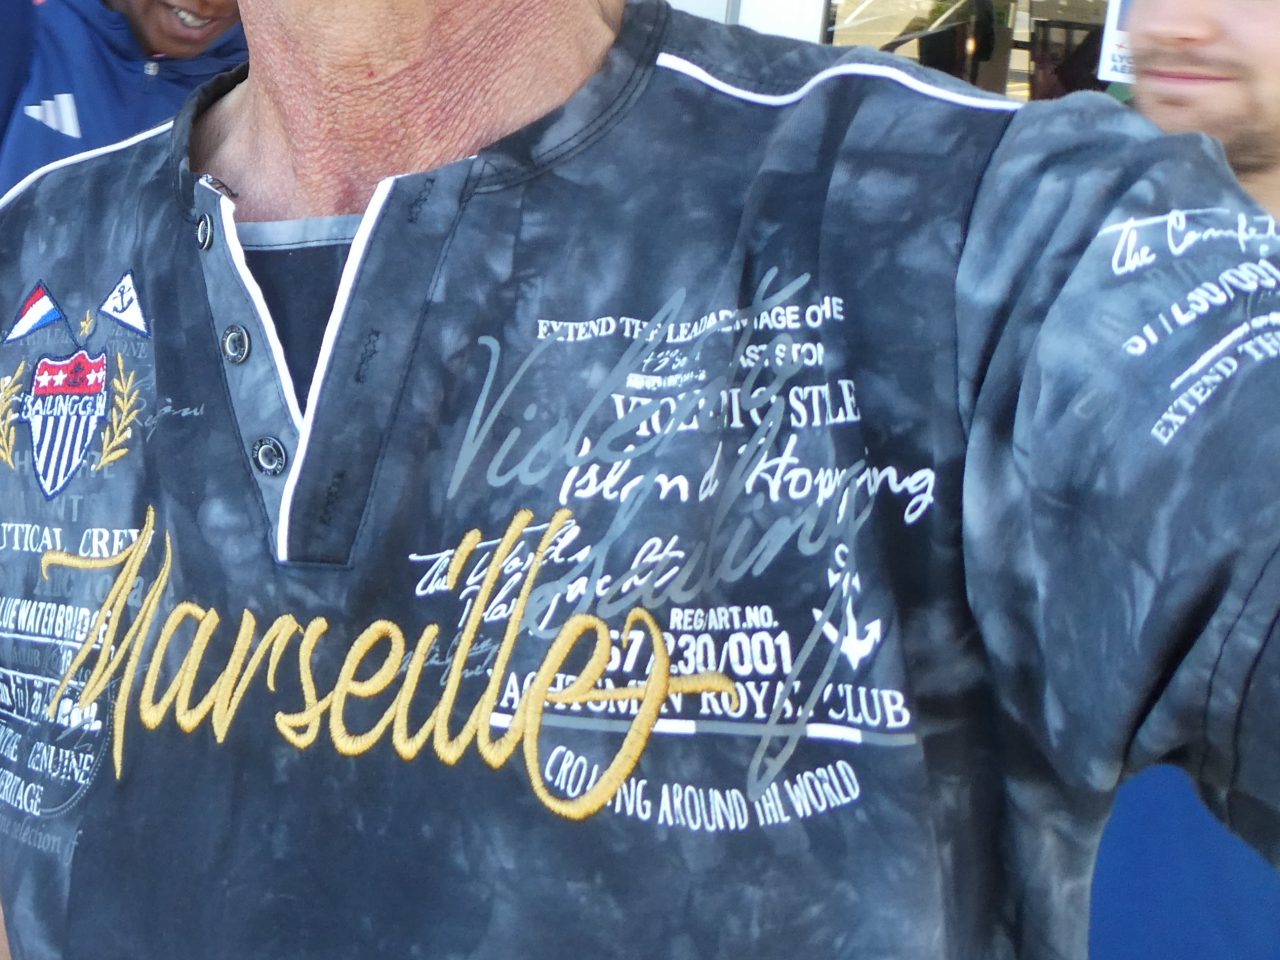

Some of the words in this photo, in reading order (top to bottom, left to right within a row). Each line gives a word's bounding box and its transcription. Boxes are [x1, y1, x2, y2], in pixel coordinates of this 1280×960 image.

[1150, 356, 1239, 446] EXTEND
[17, 598, 57, 636] WATER
[42, 504, 740, 822] Marseille
[657, 783, 750, 832] AROUND
[784, 759, 860, 819] WORLD
